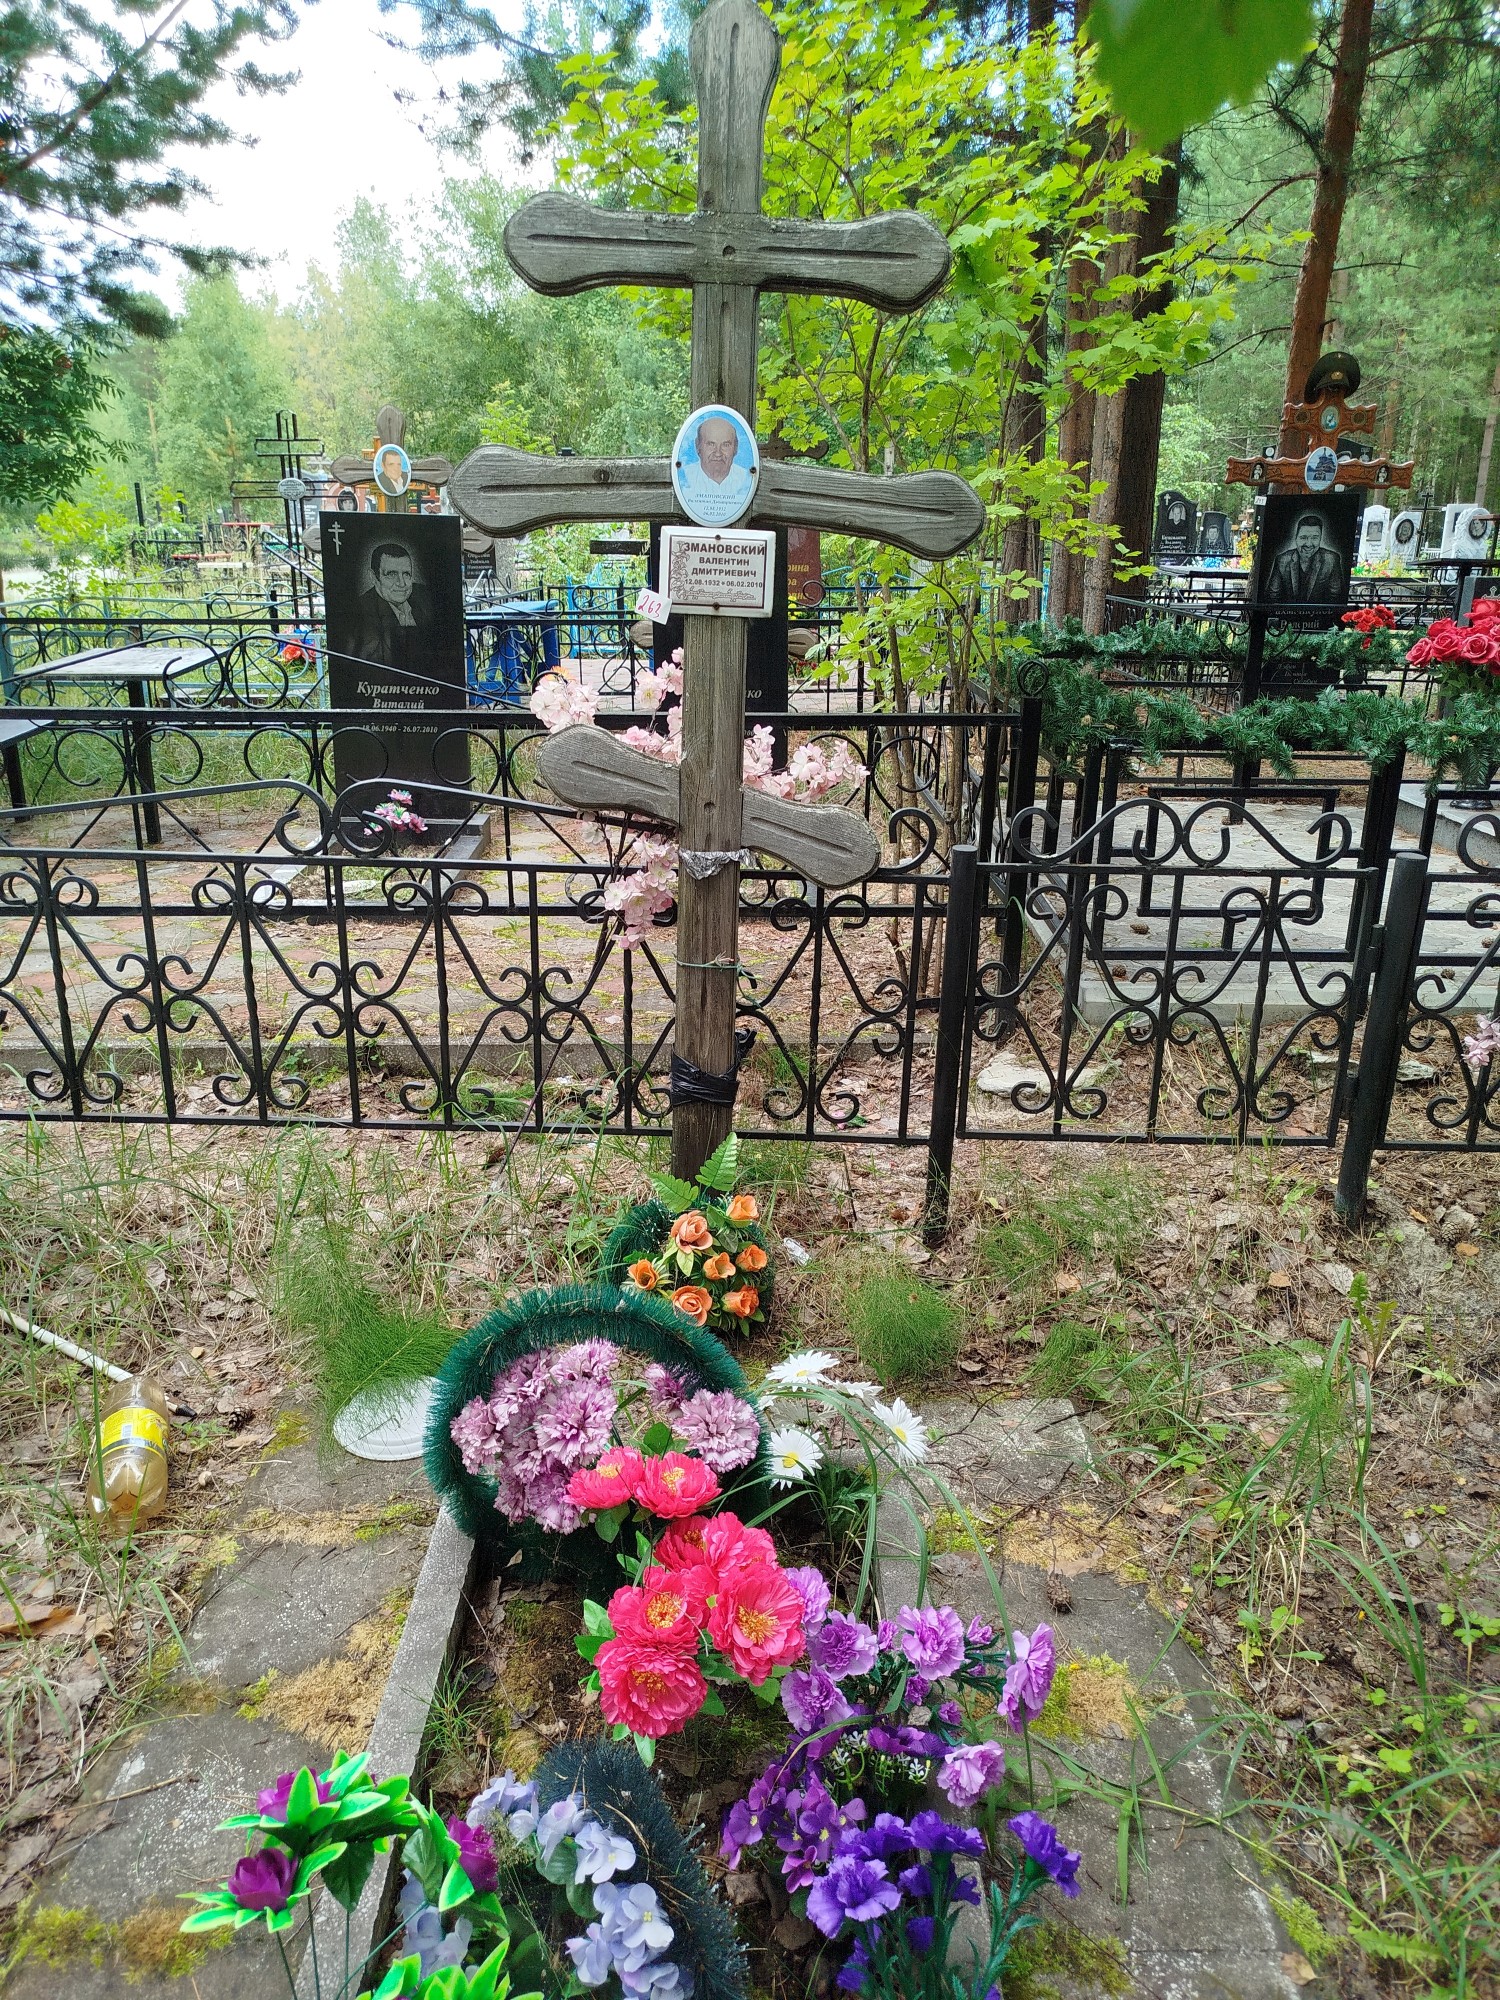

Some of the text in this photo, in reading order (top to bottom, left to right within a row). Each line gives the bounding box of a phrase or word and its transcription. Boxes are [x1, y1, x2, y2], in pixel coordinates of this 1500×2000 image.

[684, 542, 765, 556] ЗМАНОВСКИЙ
[699, 556, 750, 566] ВАЛЕНТИН
[691, 567, 757, 578] ДМИТРИЕВИЧ
[684, 578, 763, 588] 12.08.1932 06.02.2010
[356, 681, 440, 697] Куратченко
[372, 697, 425, 709] Виталий
[402, 725, 438, 733] 26.07.2010
